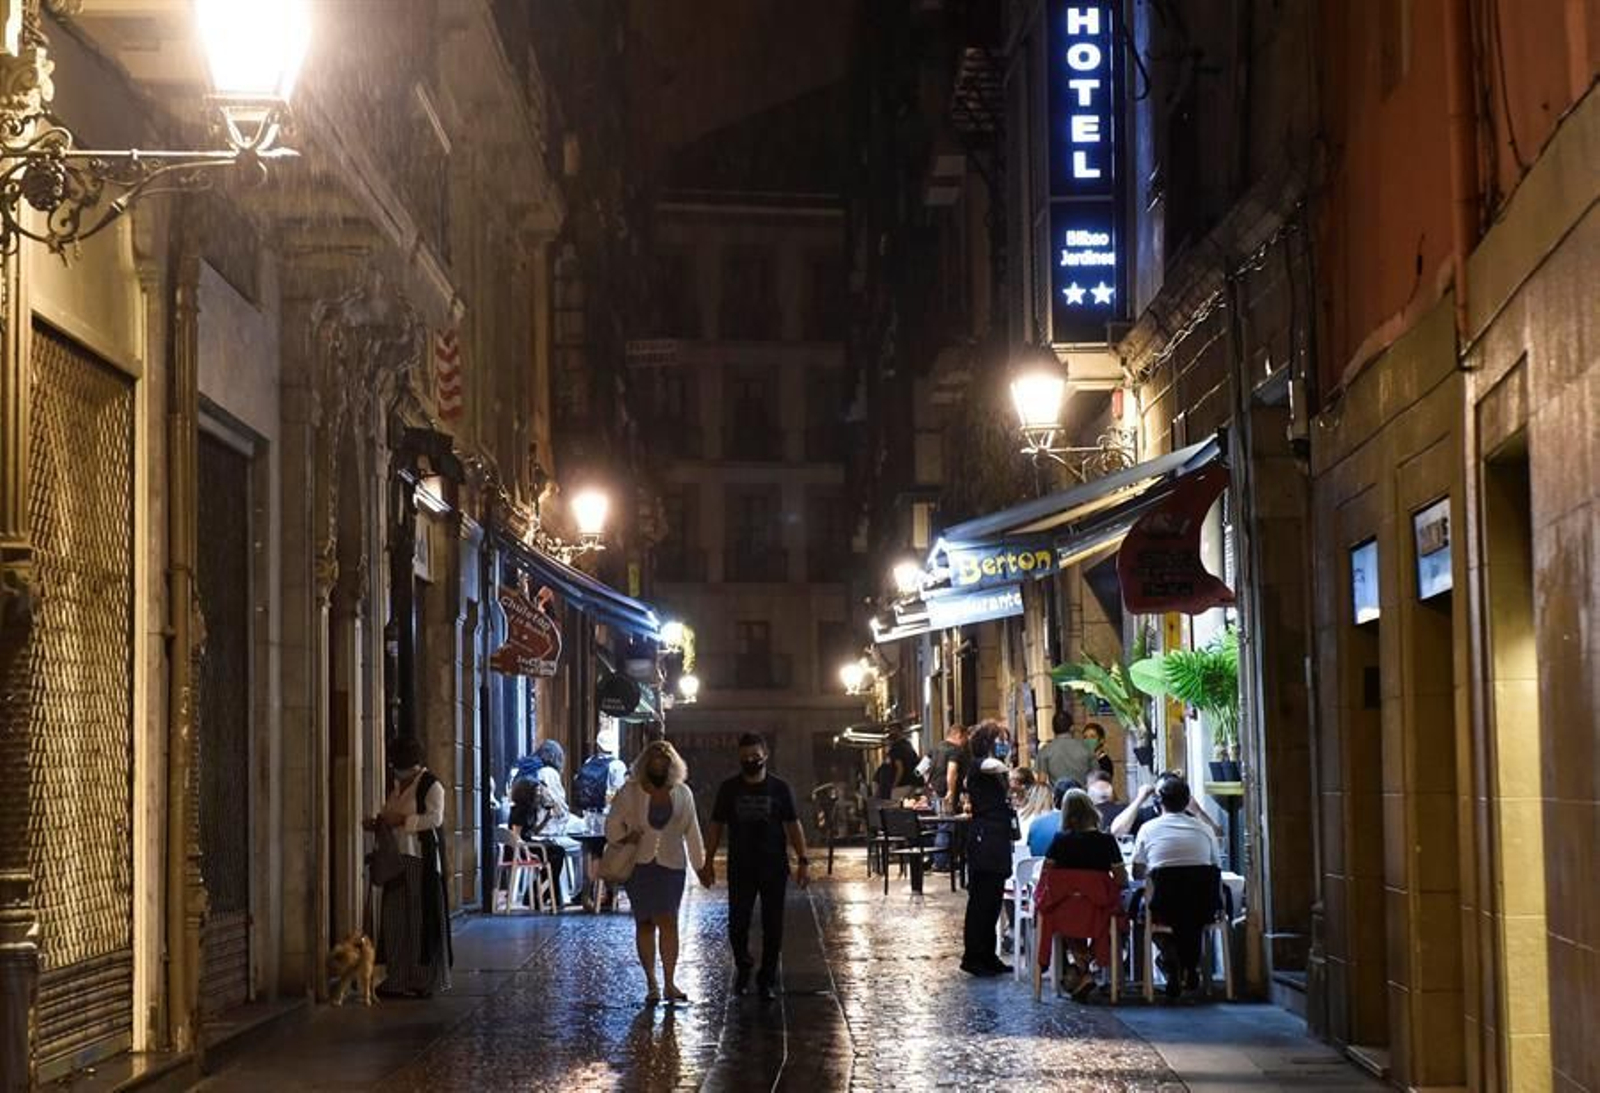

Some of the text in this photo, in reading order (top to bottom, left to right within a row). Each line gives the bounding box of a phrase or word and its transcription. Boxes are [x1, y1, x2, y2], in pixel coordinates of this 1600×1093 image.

[1066, 7, 1101, 179] HOTEL
[1065, 230, 1109, 246] Bilbao
[958, 548, 1051, 585] Berton
